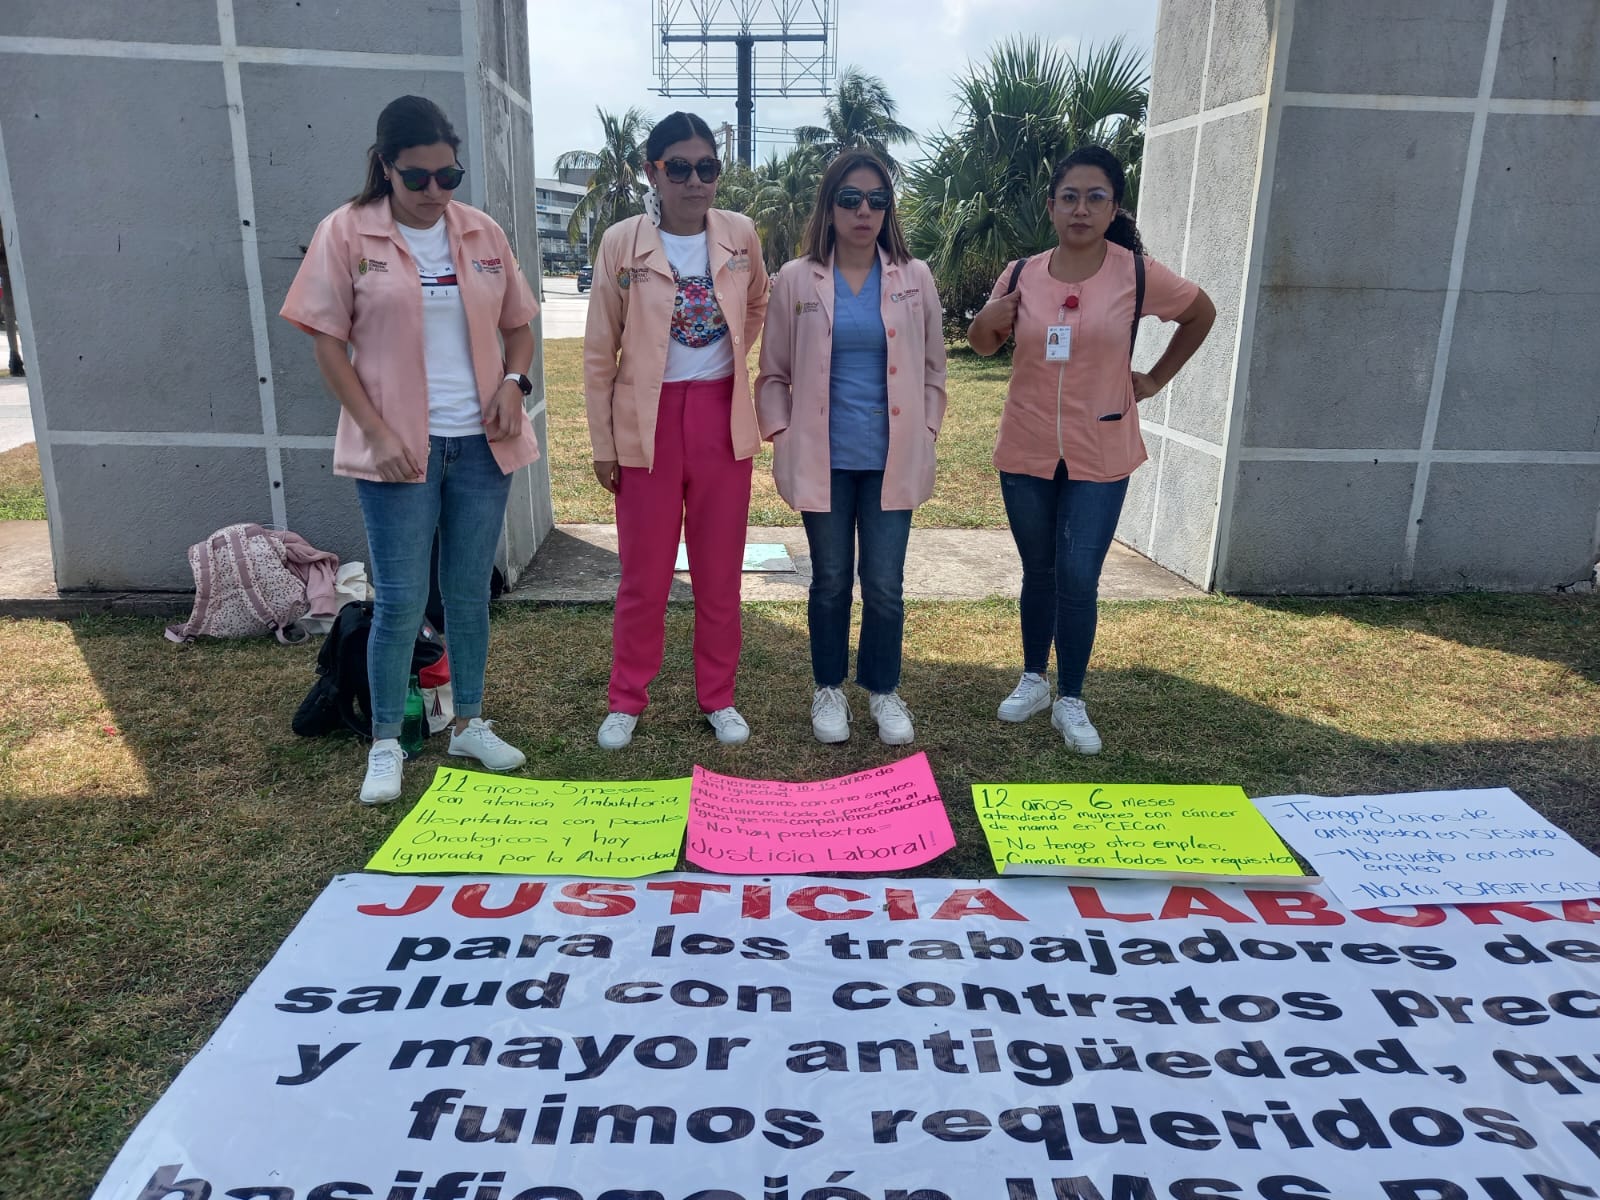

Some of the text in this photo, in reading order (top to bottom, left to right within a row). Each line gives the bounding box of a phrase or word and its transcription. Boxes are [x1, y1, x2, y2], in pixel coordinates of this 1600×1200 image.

[875, 767, 894, 777] de
[432, 772, 468, 792] 11
[553, 783, 578, 795] 5
[582, 787, 655, 795] meses
[437, 795, 463, 805] con
[905, 791, 918, 801] al
[982, 788, 1176, 811] 12 años 6 meses
[416, 809, 548, 825] Hospitalaria
[734, 816, 759, 824] que
[983, 808, 1238, 823] atendiendo mujeres con cáncer
[1272, 801, 1364, 825] Tengo
[1363, 804, 1396, 824] 8
[1461, 808, 1495, 820] de
[737, 825, 770, 839] hay
[988, 821, 1008, 831] de
[1073, 823, 1097, 831] en
[1436, 830, 1470, 840] en
[562, 836, 572, 847] y
[593, 829, 630, 848] hoy
[1043, 836, 1096, 854] tengo
[1106, 834, 1145, 848] otro
[393, 848, 484, 867] Ignorada
[499, 853, 536, 865] por
[547, 851, 563, 863] la
[691, 838, 815, 863] Justicia
[1385, 849, 1456, 864] cuento
[1466, 850, 1507, 861] con
[1508, 847, 1554, 859] otro
[1078, 855, 1105, 864] con
[1113, 850, 1168, 865] todos
[1175, 854, 1205, 865] los
[1211, 853, 1294, 871] requisitos
[1363, 863, 1441, 876] empleo
[1400, 881, 1440, 896] fui
[1443, 880, 1600, 896] BASIFICAD
[356, 880, 1030, 921] JUSTICIA
[385, 924, 1600, 975] para los trabajadores de
[274, 972, 569, 1014] salud
[604, 978, 792, 1013] con
[832, 979, 1343, 1025] contratos
[275, 1042, 362, 1086] y
[388, 1033, 751, 1082] mayor
[785, 1028, 1467, 1086] antigüedad,
[407, 1089, 825, 1149] fuimos
[871, 1097, 1538, 1161] requeridos
